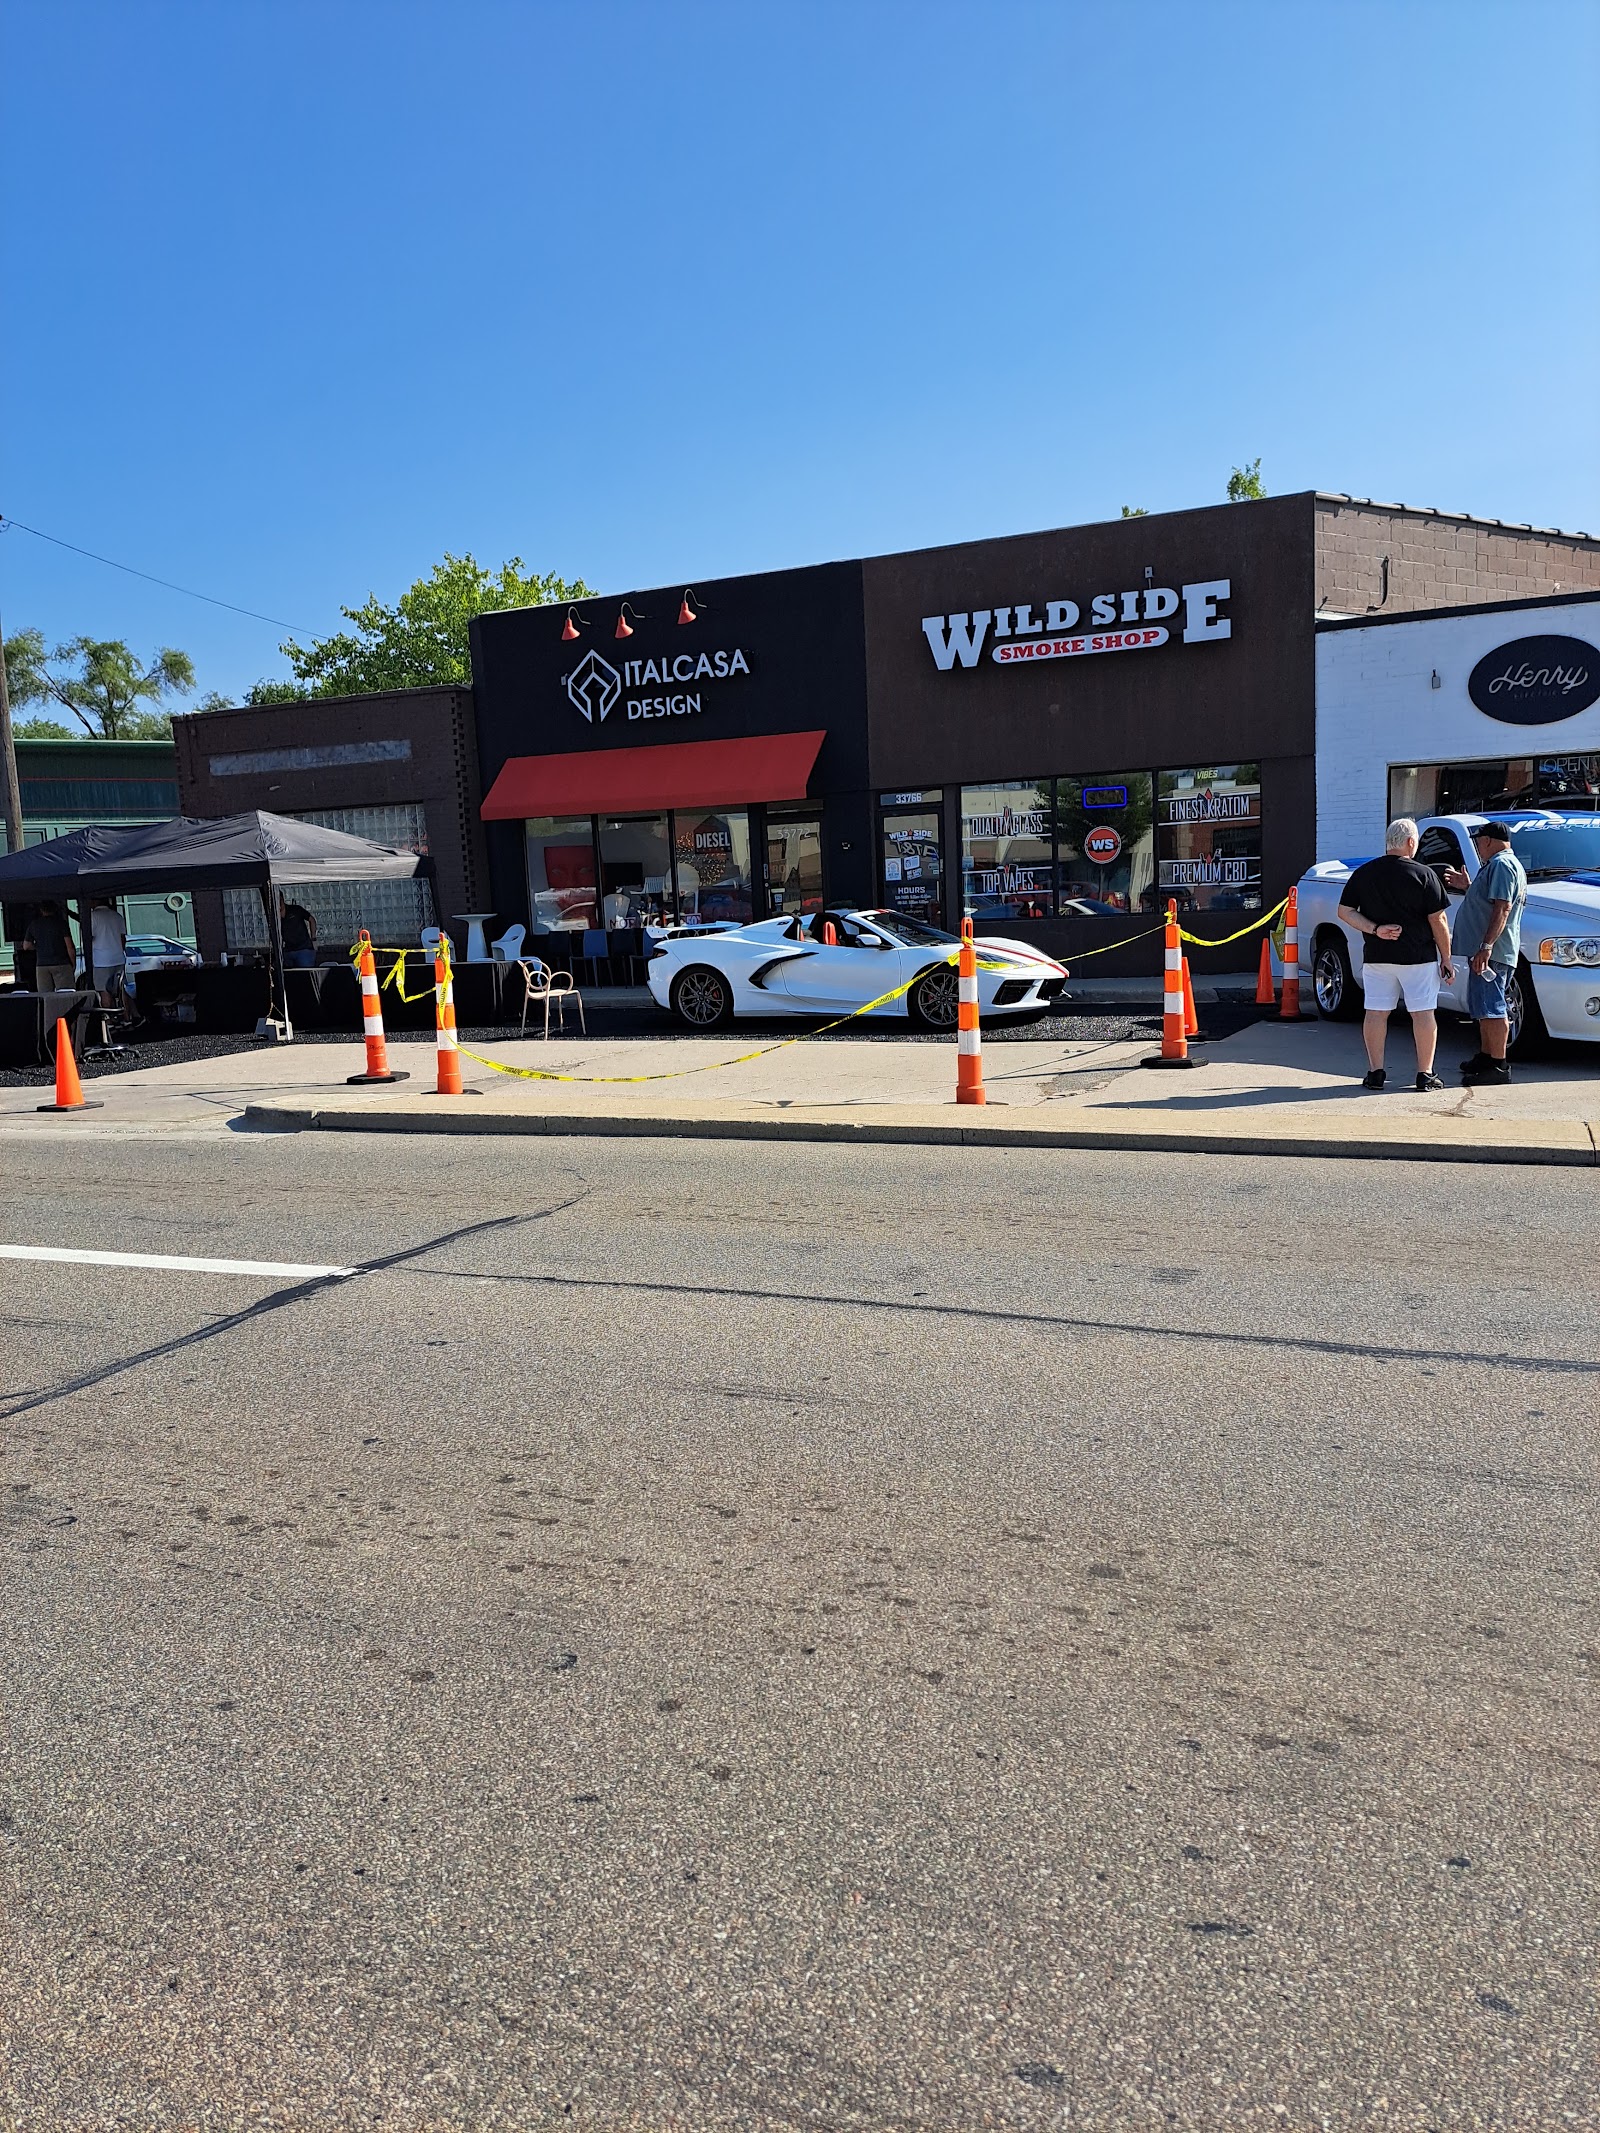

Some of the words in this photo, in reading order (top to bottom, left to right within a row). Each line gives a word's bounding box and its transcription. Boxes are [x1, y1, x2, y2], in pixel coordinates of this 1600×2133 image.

[921, 600, 1080, 671] WILD
[1091, 578, 1232, 644] SIDE
[1000, 638, 1086, 661] SMOKE
[1091, 630, 1160, 651] SHOP
[624, 648, 751, 688] ITALCASA
[1488, 662, 1589, 695] Henry
[626, 693, 702, 721] DESIGN
[1197, 769, 1219, 780] VIBES
[1543, 756, 1590, 773] OPEN
[895, 792, 922, 804] 33766
[1169, 799, 1205, 821] FINEST
[1207, 796, 1250, 819] KRATOM
[889, 830, 909, 840] WILD
[913, 829, 933, 838] SIDE
[972, 814, 1010, 836] QUALITY
[1012, 813, 1043, 834] GLASS
[695, 831, 731, 848] DIESEL
[1091, 838, 1115, 851] WS
[981, 873, 1000, 893] TOP
[1003, 871, 1034, 892] VAPES
[1172, 861, 1221, 884] PREMIUM
[1225, 861, 1248, 882] CBD
[897, 886, 926, 894] HOURS
